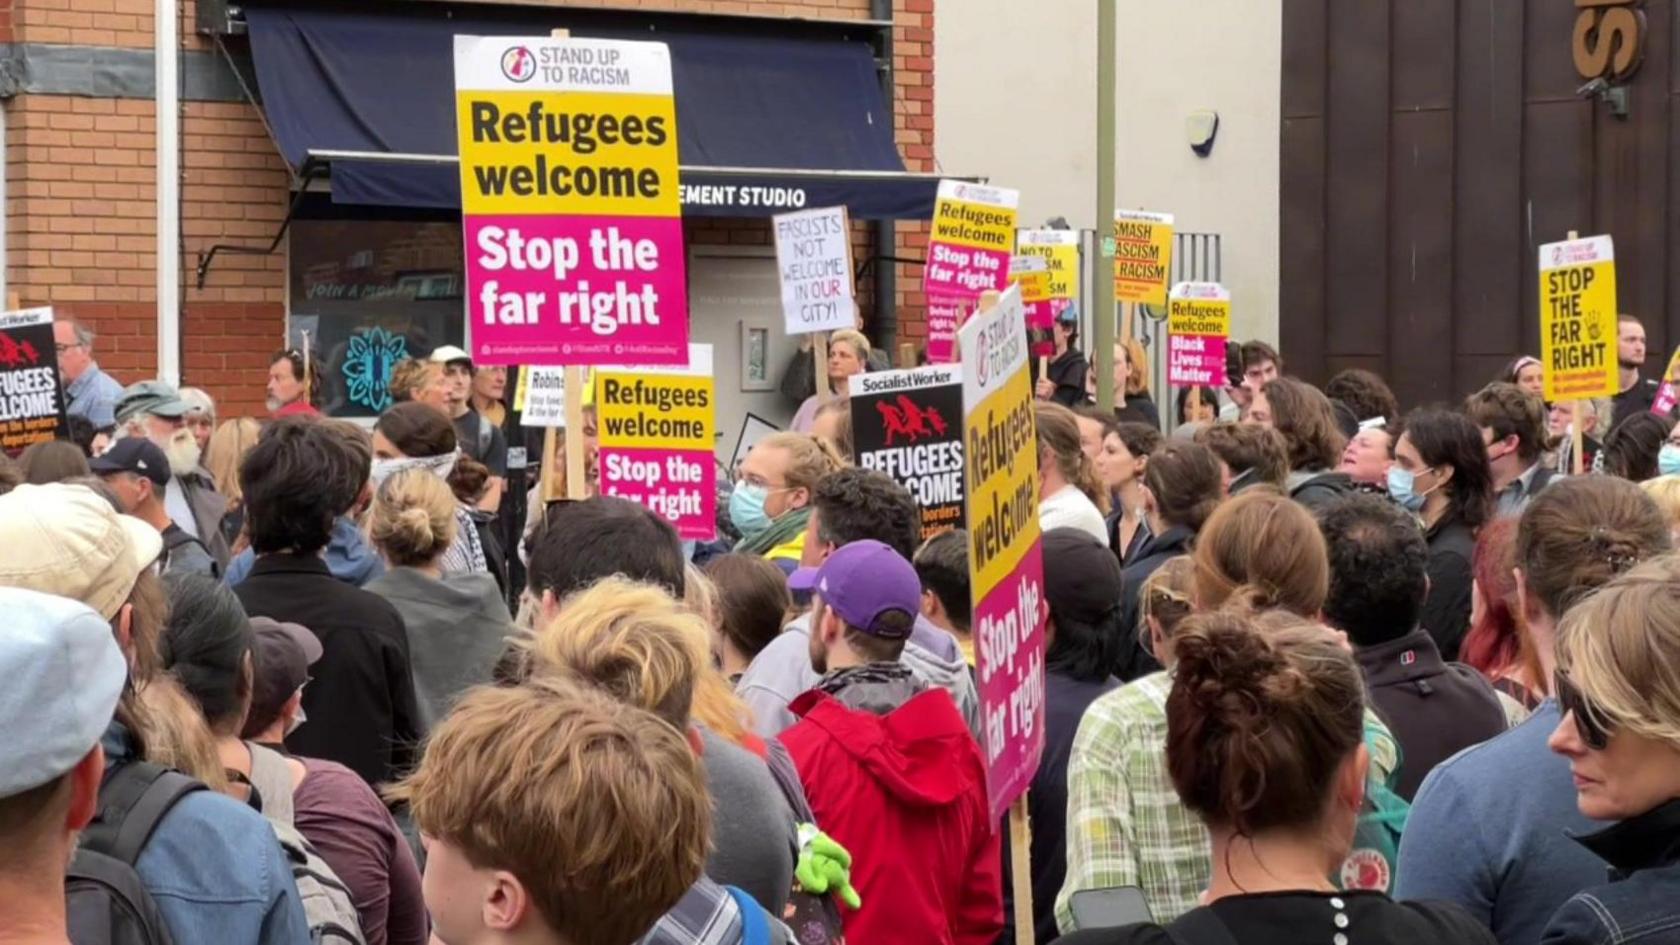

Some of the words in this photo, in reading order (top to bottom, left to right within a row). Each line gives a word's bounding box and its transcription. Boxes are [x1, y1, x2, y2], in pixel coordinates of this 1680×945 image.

[540, 47, 593, 65] STAND
[598, 49, 620, 65] UP
[541, 67, 563, 83] TO
[568, 68, 630, 86] RACISM
[471, 101, 667, 154] Refugees
[474, 154, 660, 198] welcome
[739, 187, 806, 207] STUDIO
[940, 202, 1012, 227] Refugees
[778, 215, 842, 240] FASCISTS
[938, 222, 1006, 245] welcome
[477, 225, 579, 280] Stop
[589, 227, 659, 271] the
[793, 238, 825, 259] NOT
[933, 245, 969, 267] Stop
[973, 248, 999, 270] the
[784, 257, 844, 282] WELCOME
[930, 265, 953, 282] far
[957, 271, 997, 290] right
[1119, 262, 1165, 280] RACISM
[1549, 266, 1595, 294] STOP
[795, 285, 808, 300] IN
[811, 279, 841, 298] OUR
[480, 280, 546, 325] far
[558, 280, 660, 335] right
[801, 301, 838, 323] CITY!
[1172, 302, 1225, 320] Refugees
[1550, 294, 1582, 319] THE
[1172, 318, 1223, 333] welcome
[1550, 320, 1581, 345] FAR
[1171, 335, 1205, 352] Black
[1171, 351, 1202, 367] Lives
[1552, 343, 1606, 371] RIGHT
[863, 375, 912, 392] Socialist
[913, 371, 951, 386] Worker
[1170, 366, 1212, 382] Matter
[604, 379, 708, 411] Refugees
[605, 412, 704, 438] welcome
[970, 399, 1033, 489] Refugees
[606, 453, 661, 486] Stop
[666, 456, 702, 482] the
[649, 488, 702, 520] right
[973, 473, 1034, 573] welcome
[978, 608, 1018, 684] Stop
[1018, 574, 1040, 643] the
[986, 700, 1006, 766] far
[1010, 646, 1044, 739] right
